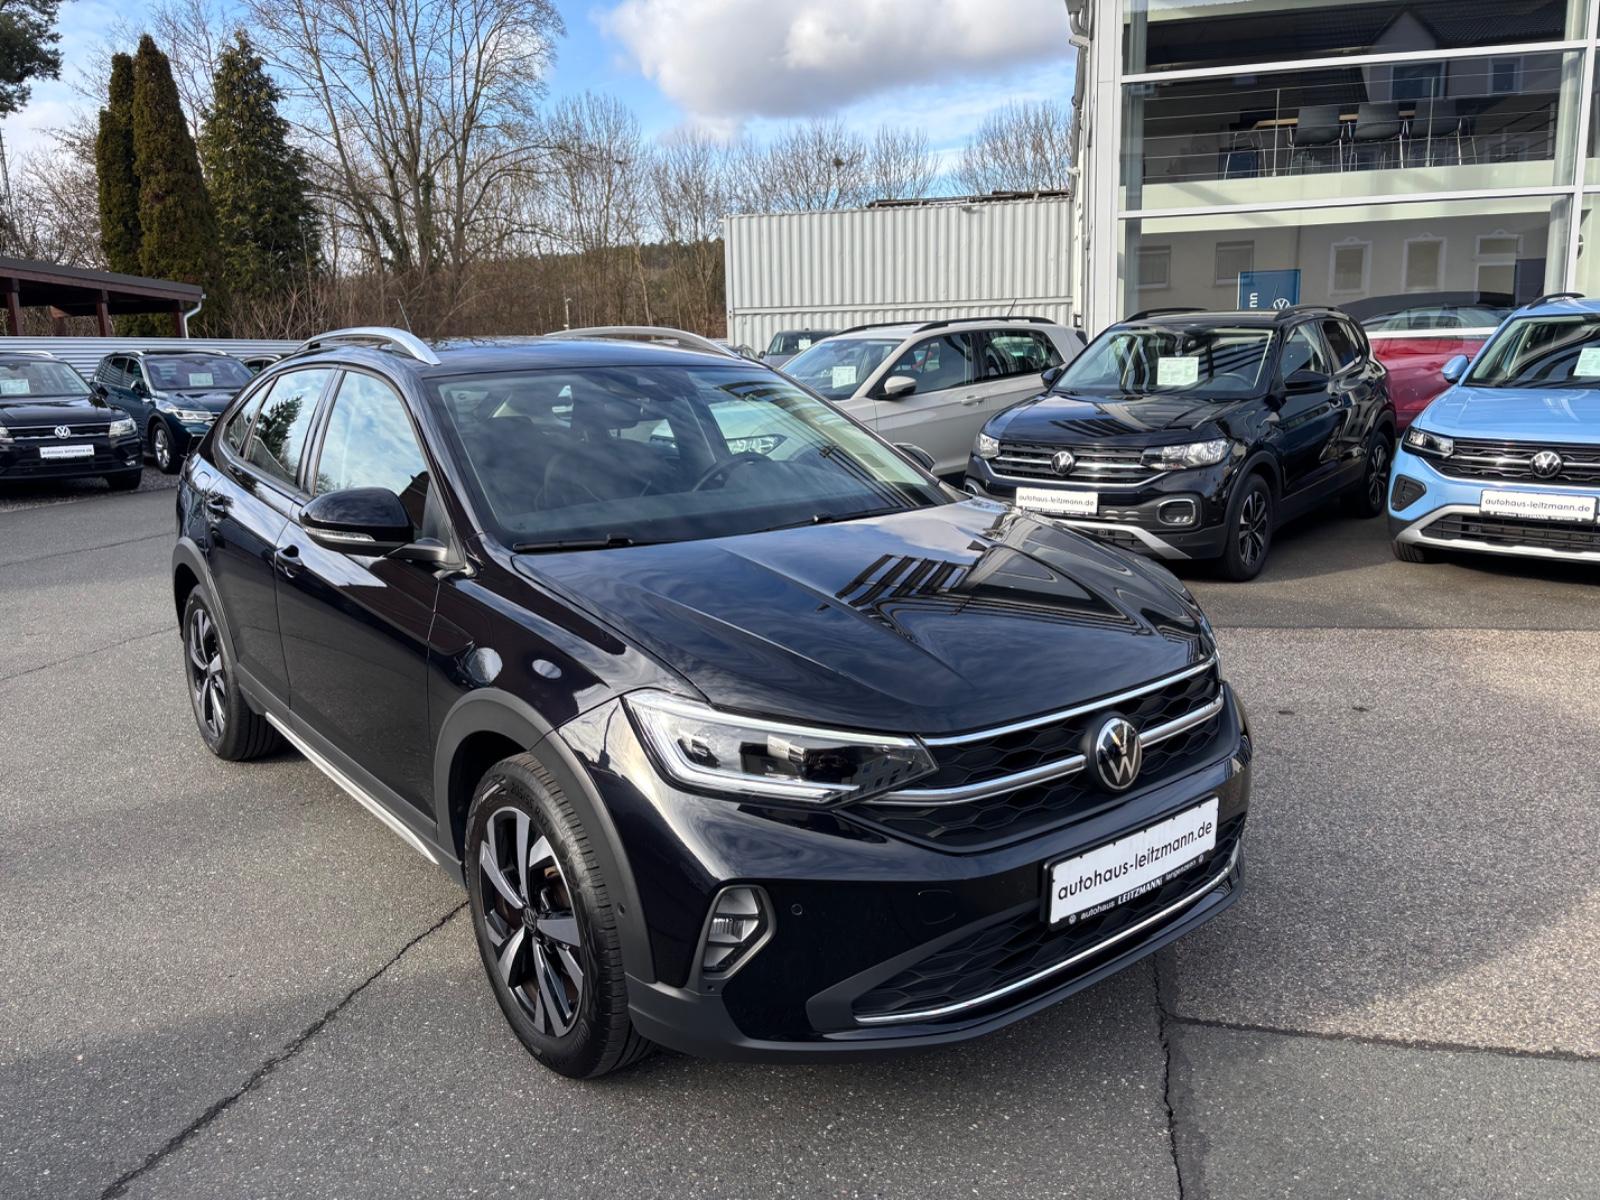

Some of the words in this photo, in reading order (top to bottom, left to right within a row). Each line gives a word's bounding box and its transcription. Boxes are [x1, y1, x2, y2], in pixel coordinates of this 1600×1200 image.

[1485, 497, 1591, 513] autohaus-leitzmann.de
[1058, 821, 1212, 900] autohaus-leitzmann.de
[1081, 901, 1115, 920] autohaus
[1117, 876, 1163, 905] LEITZMANN
